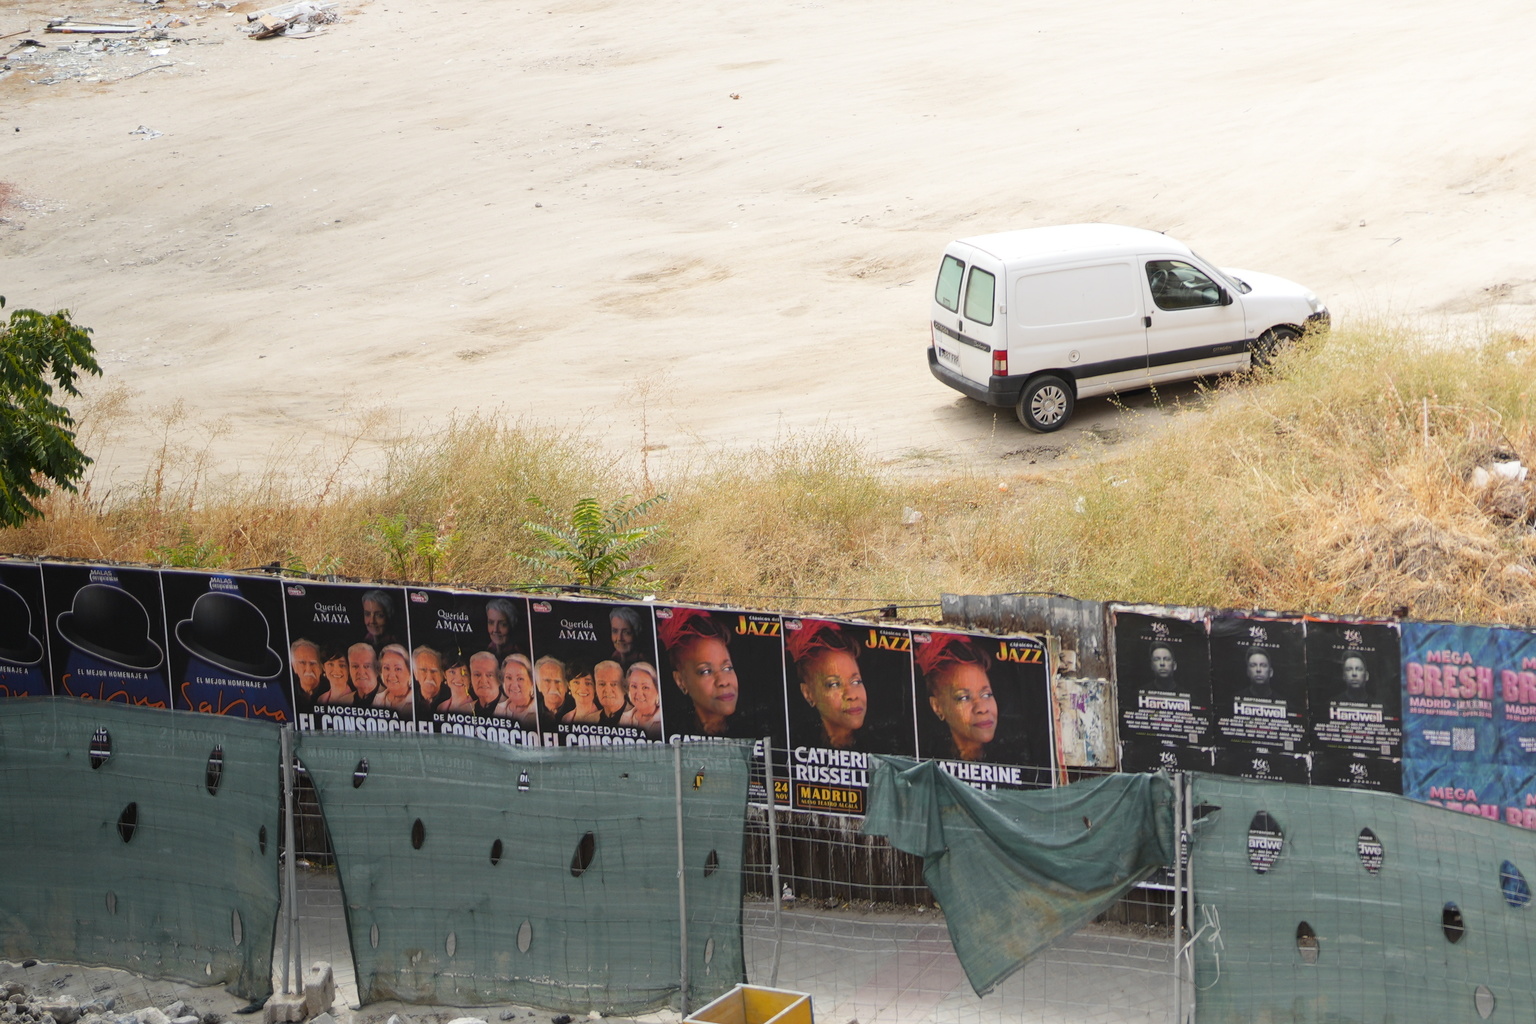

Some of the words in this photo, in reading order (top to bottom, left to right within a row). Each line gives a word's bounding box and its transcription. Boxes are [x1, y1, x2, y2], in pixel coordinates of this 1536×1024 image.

[90, 569, 113, 577] MALAS
[210, 577, 232, 585] MALAS
[314, 602, 347, 613] Querida
[437, 609, 470, 621] Querida
[312, 613, 350, 624] AMAYA
[435, 620, 473, 633] AMAYA
[560, 618, 594, 629] Querida
[735, 615, 781, 637] JAZZ
[558, 629, 598, 641] AMAYA
[865, 629, 911, 653] JAZZ
[995, 642, 1043, 665] JAZZ
[1426, 650, 1473, 665] MEGA
[86, 669, 107, 677] MEJOR
[108, 670, 142, 679] HOMENAJE
[143, 672, 148, 680] A
[196, 676, 203, 684] EL
[205, 677, 226, 685] MEJOR
[227, 679, 261, 688] HOMENAJE
[1406, 662, 1494, 701] BRESH
[180, 682, 288, 721] Sabina
[1138, 695, 1191, 712] Hardwell
[1409, 697, 1452, 710] MADRID
[313, 705, 326, 713] DE
[327, 705, 391, 718] MOCEDADES
[392, 711, 399, 719] A
[1233, 701, 1287, 719] Hardwell
[1329, 706, 1383, 723] Hardwell
[299, 713, 315, 731] EL
[321, 714, 415, 734] CONSORCIO
[433, 713, 445, 721] DE
[447, 713, 512, 727] MOCEDADES
[514, 720, 521, 729] A
[441, 722, 540, 746] CONSORCIO
[558, 724, 570, 733] DE
[572, 724, 637, 738] MOCEDADES
[640, 730, 646, 738] A
[794, 746, 868, 769] CATHERI
[796, 764, 870, 787] RUSSELL
[938, 760, 1022, 785] ATHERINE
[774, 781, 789, 793] 24
[800, 786, 858, 803] MADRID
[1429, 786, 1477, 802] MEGA
